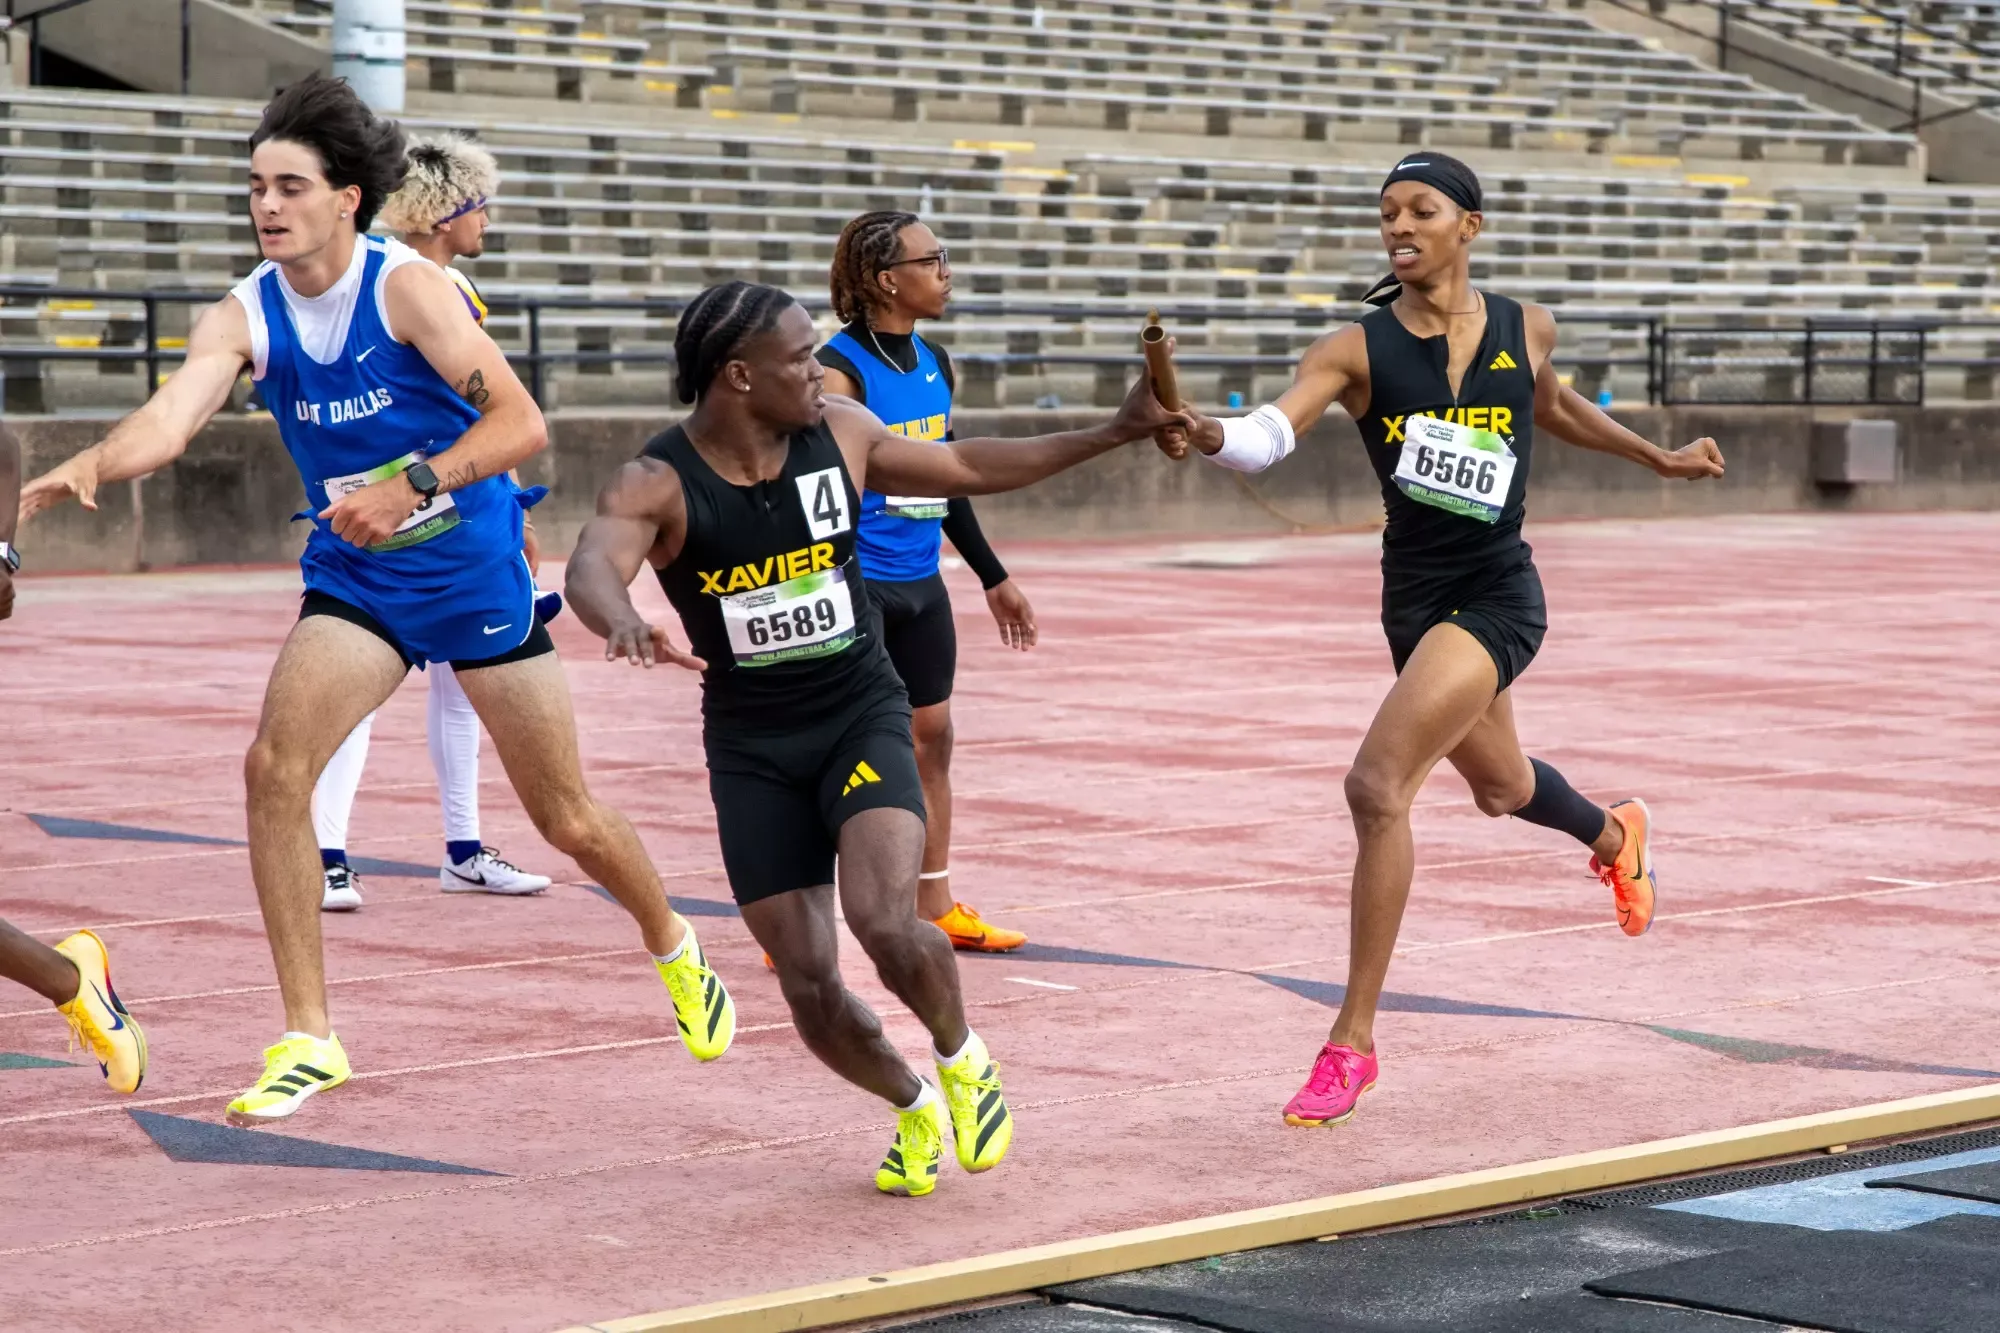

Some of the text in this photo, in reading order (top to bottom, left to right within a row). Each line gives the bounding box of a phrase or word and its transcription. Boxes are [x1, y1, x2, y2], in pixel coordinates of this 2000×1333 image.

[329, 387, 393, 424] DALLAS
[1382, 406, 1513, 443] XIER
[1414, 444, 1497, 495] 6566
[812, 473, 842, 530] 4
[697, 541, 836, 594] XAVIER
[746, 597, 837, 646] 6589
